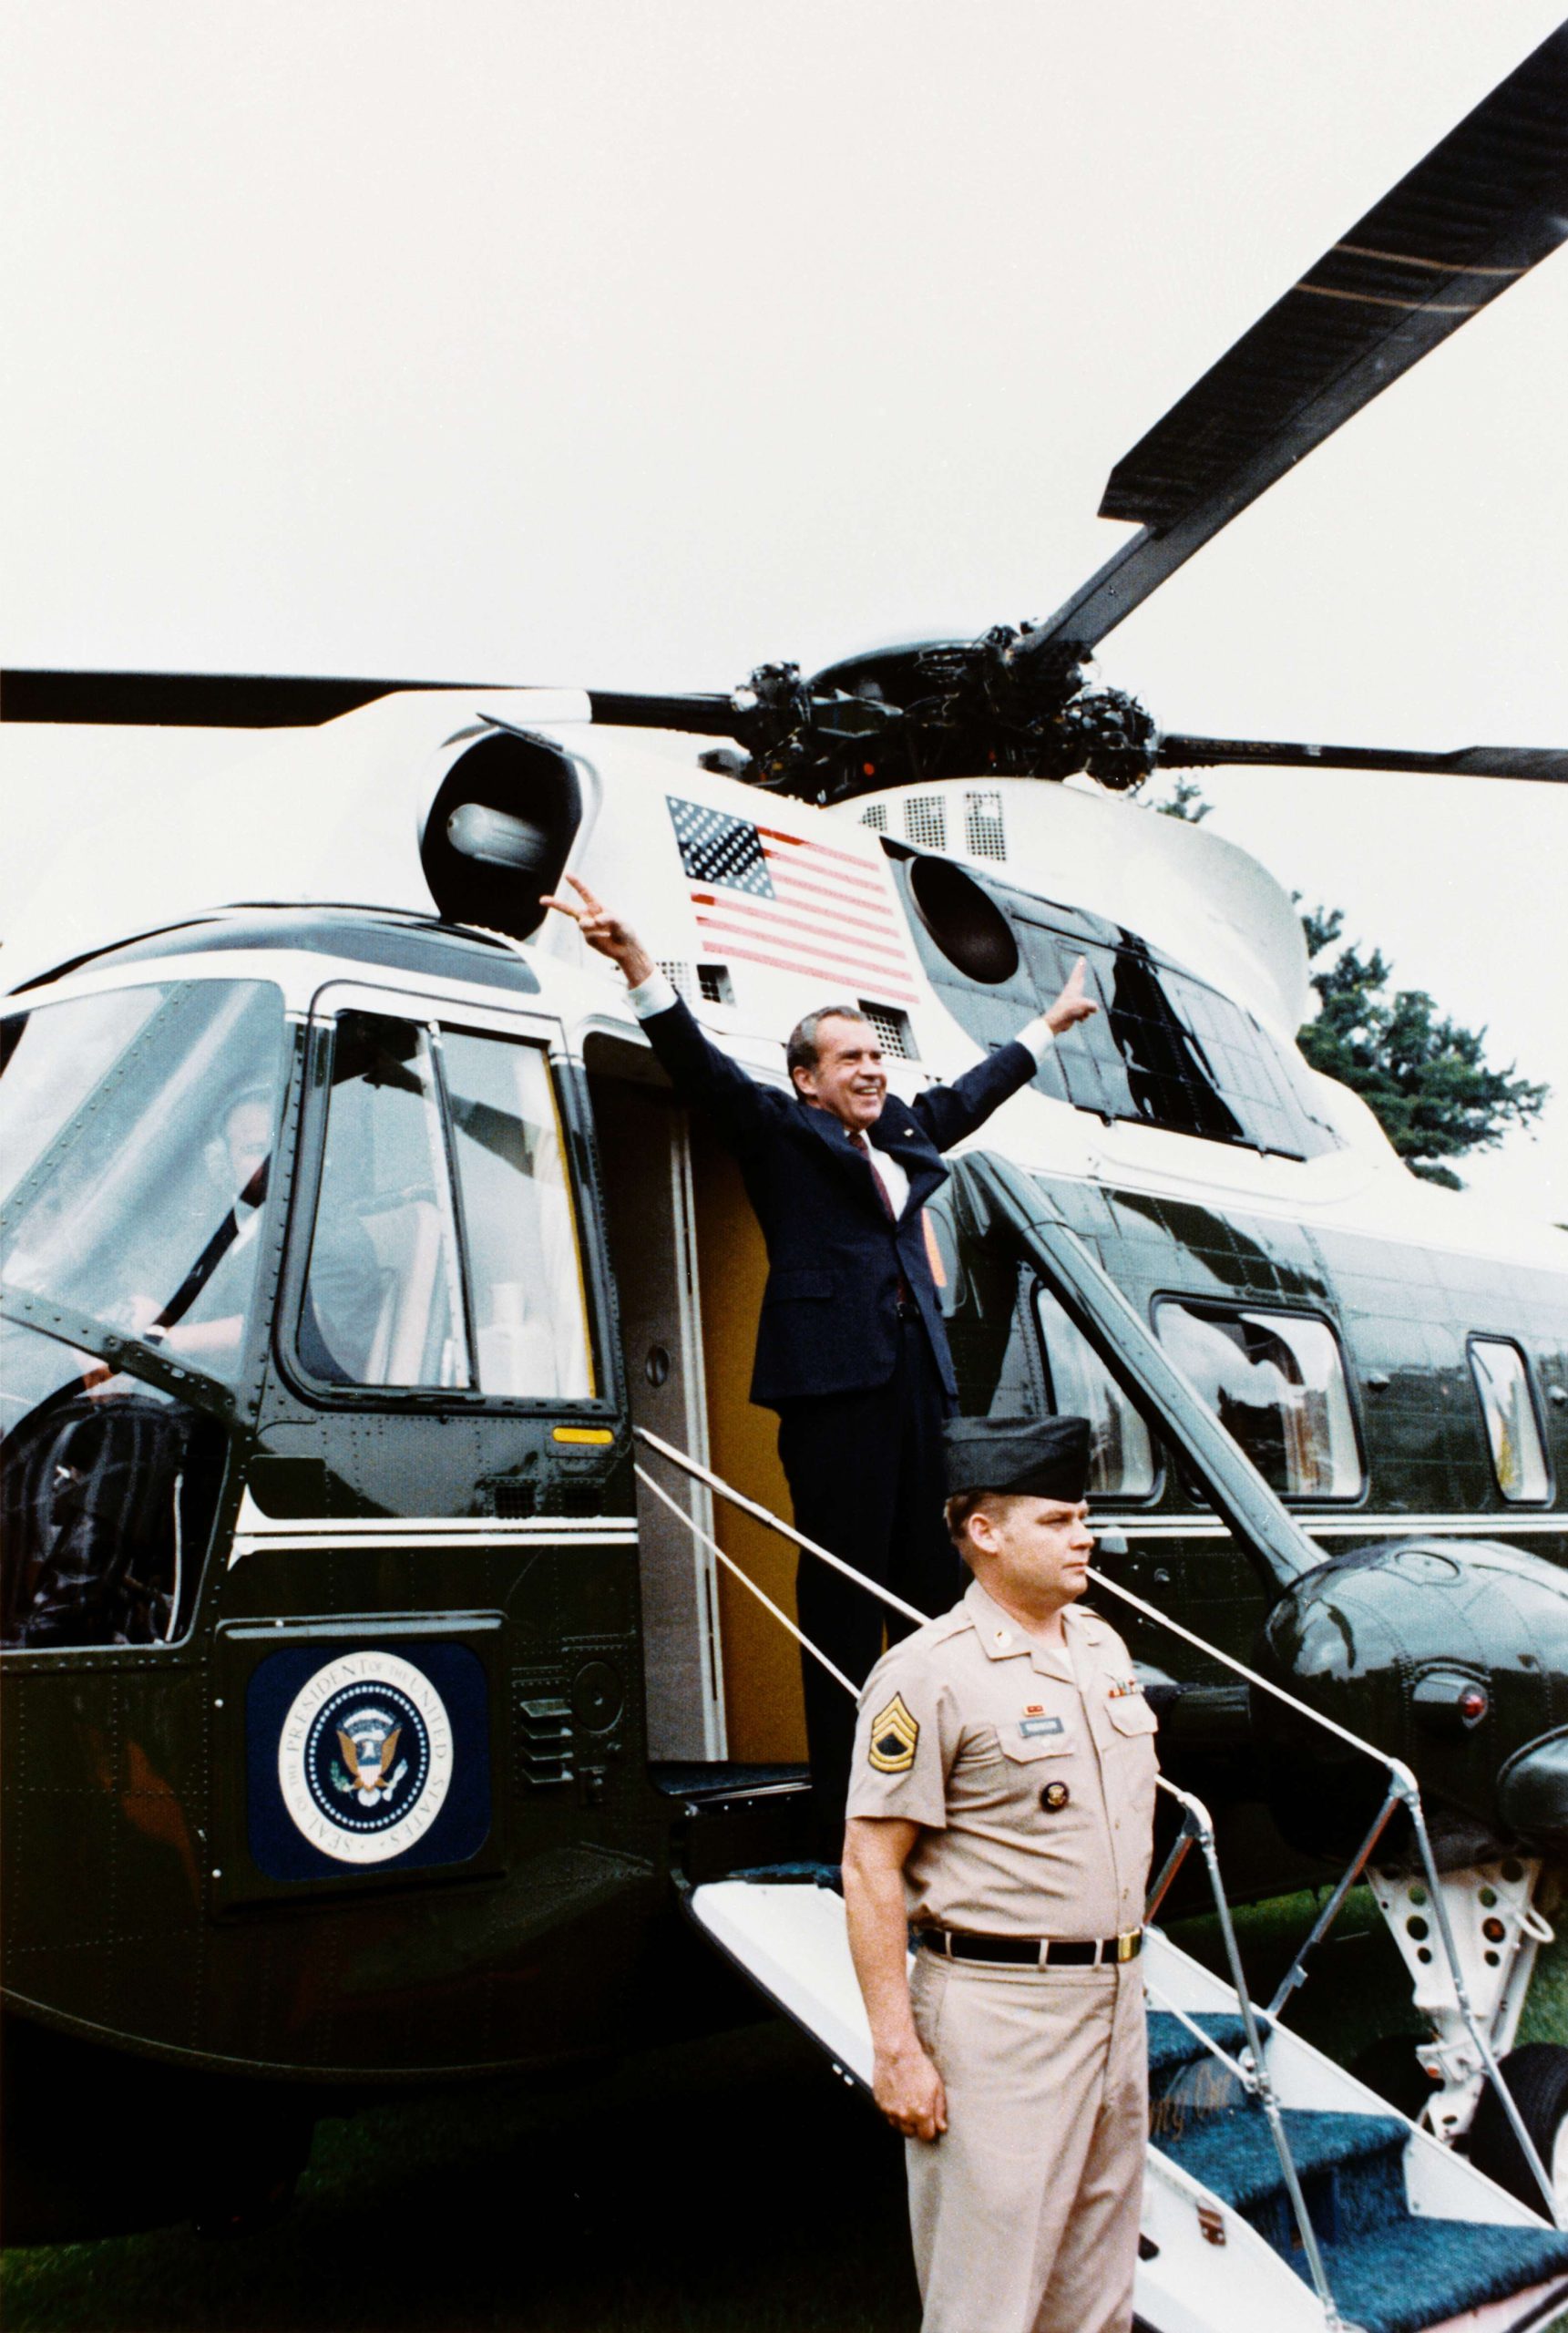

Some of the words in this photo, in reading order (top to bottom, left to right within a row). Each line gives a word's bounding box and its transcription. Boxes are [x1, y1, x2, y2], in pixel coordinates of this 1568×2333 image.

[369, 1662, 383, 1673] OF
[388, 1665, 409, 1681] THE
[286, 1659, 365, 1752] PRESIDENT
[409, 1677, 447, 1760] UNITED
[287, 1763, 300, 1788] THE
[293, 1795, 308, 1812] OF
[390, 1777, 445, 1846] STATES
[308, 1821, 354, 1853] SEAL
